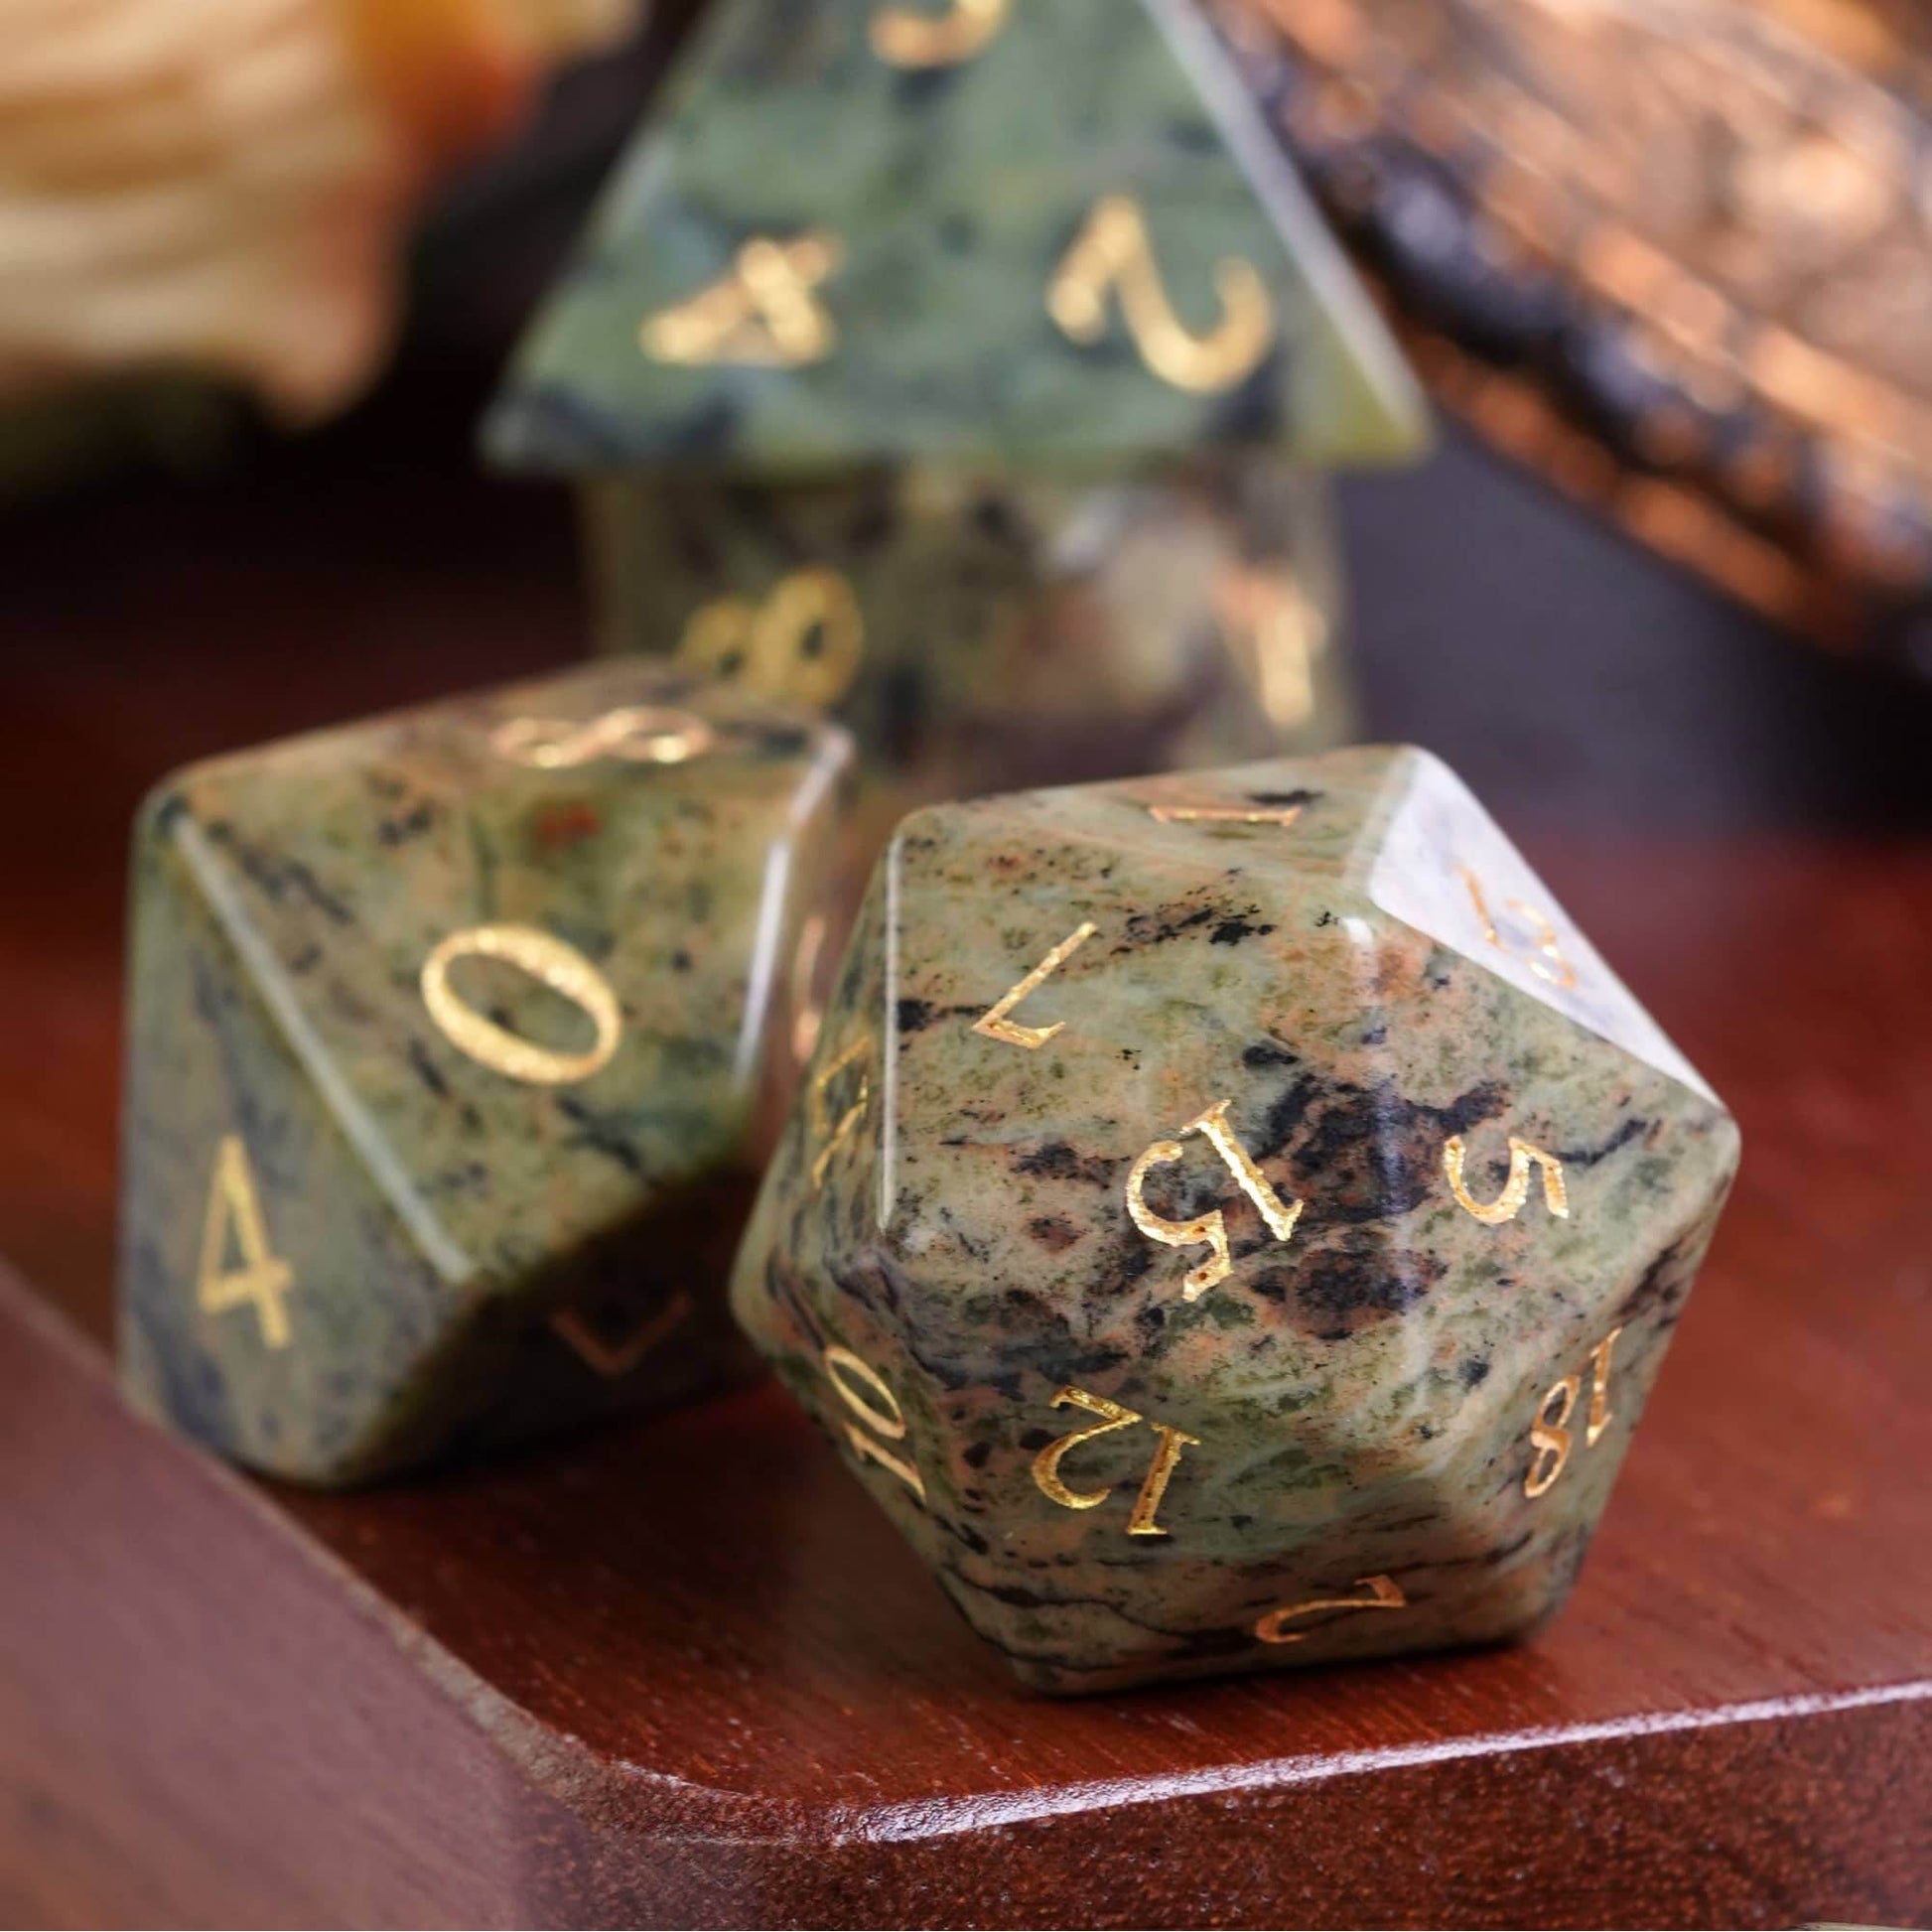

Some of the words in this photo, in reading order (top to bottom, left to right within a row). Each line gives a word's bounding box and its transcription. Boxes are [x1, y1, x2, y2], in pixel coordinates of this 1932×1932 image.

[641, 235, 844, 366] 4
[1048, 197, 1274, 393] 2
[421, 922, 621, 1084] 0
[972, 921, 1097, 1049] 7
[200, 1135, 294, 1349] 4
[1126, 1099, 1305, 1302] 15
[1444, 1135, 1569, 1223] 5
[825, 1344, 927, 1505] 10
[1031, 1385, 1200, 1536] 12
[1524, 1327, 1622, 1498] 18
[1255, 1575, 1406, 1644] 2
